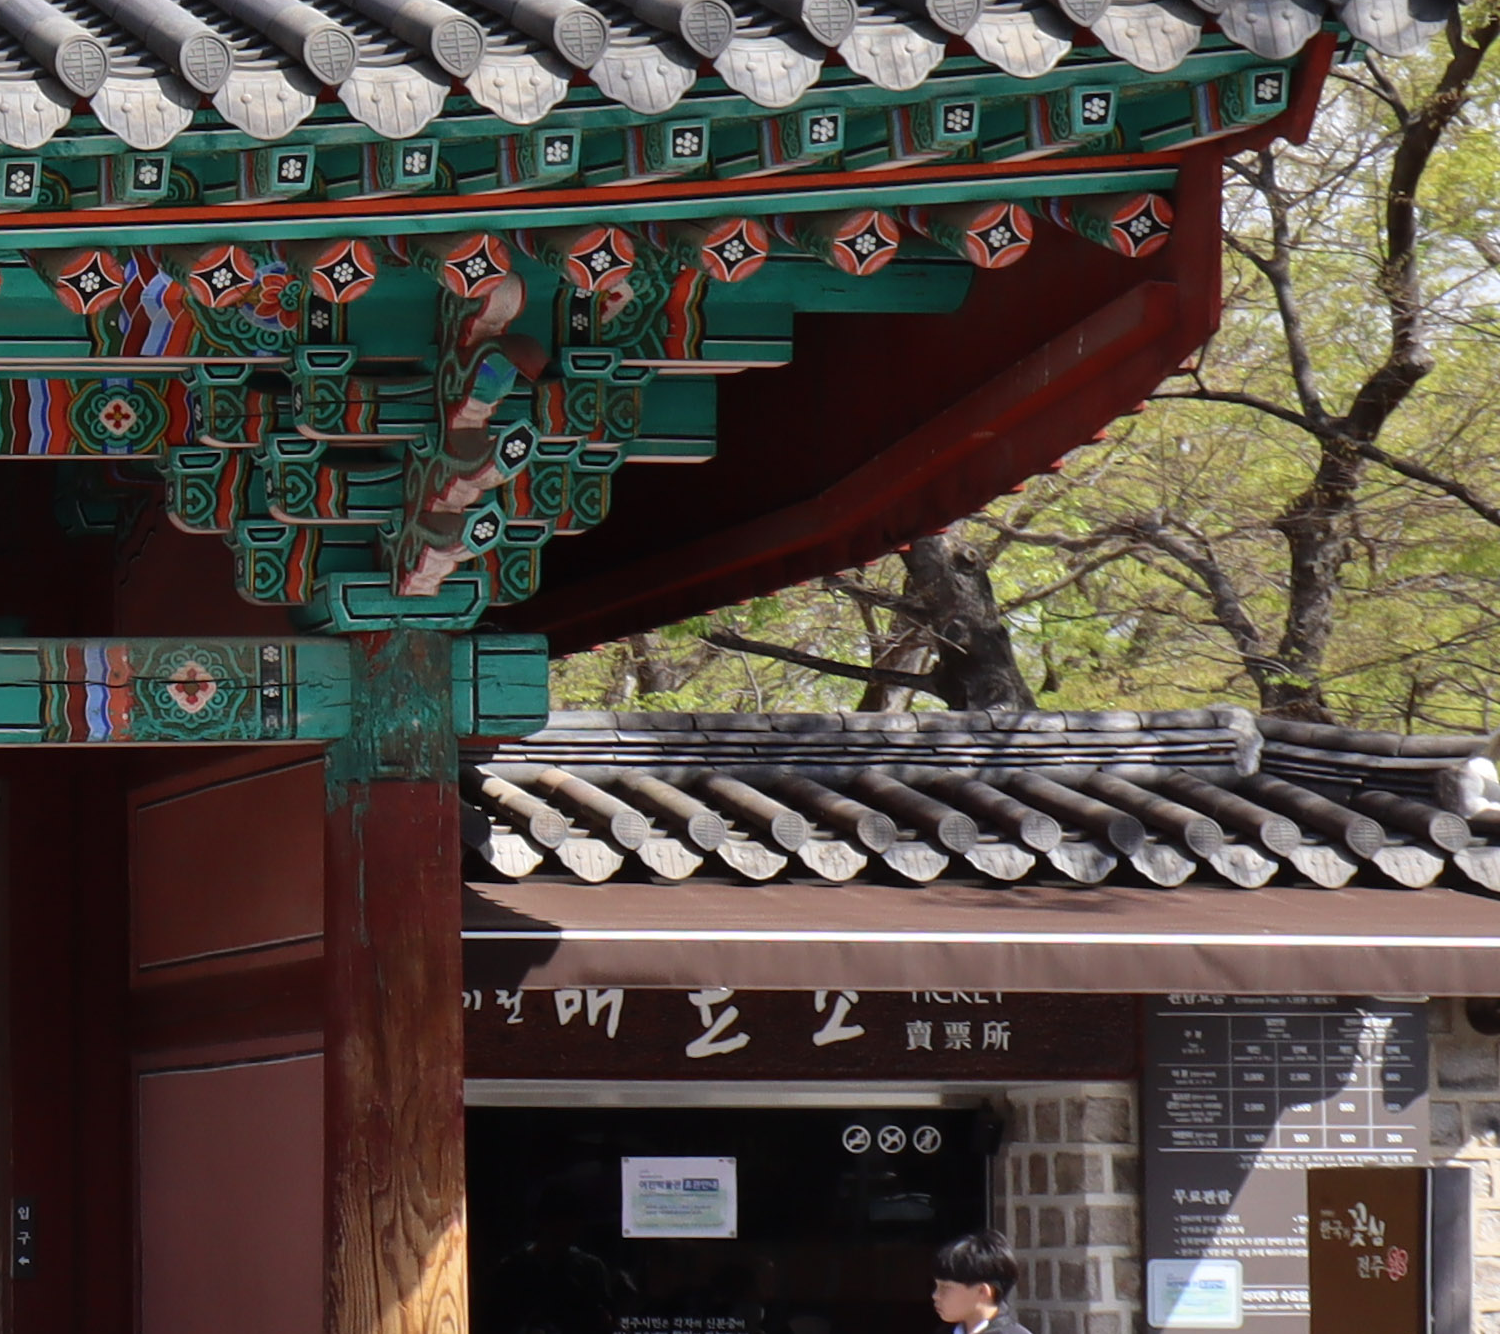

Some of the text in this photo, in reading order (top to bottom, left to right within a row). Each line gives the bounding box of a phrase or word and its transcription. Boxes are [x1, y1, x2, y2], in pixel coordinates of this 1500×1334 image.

[905, 1019, 1011, 1051] 賣票所
[17, 1206, 31, 1245] 입구
